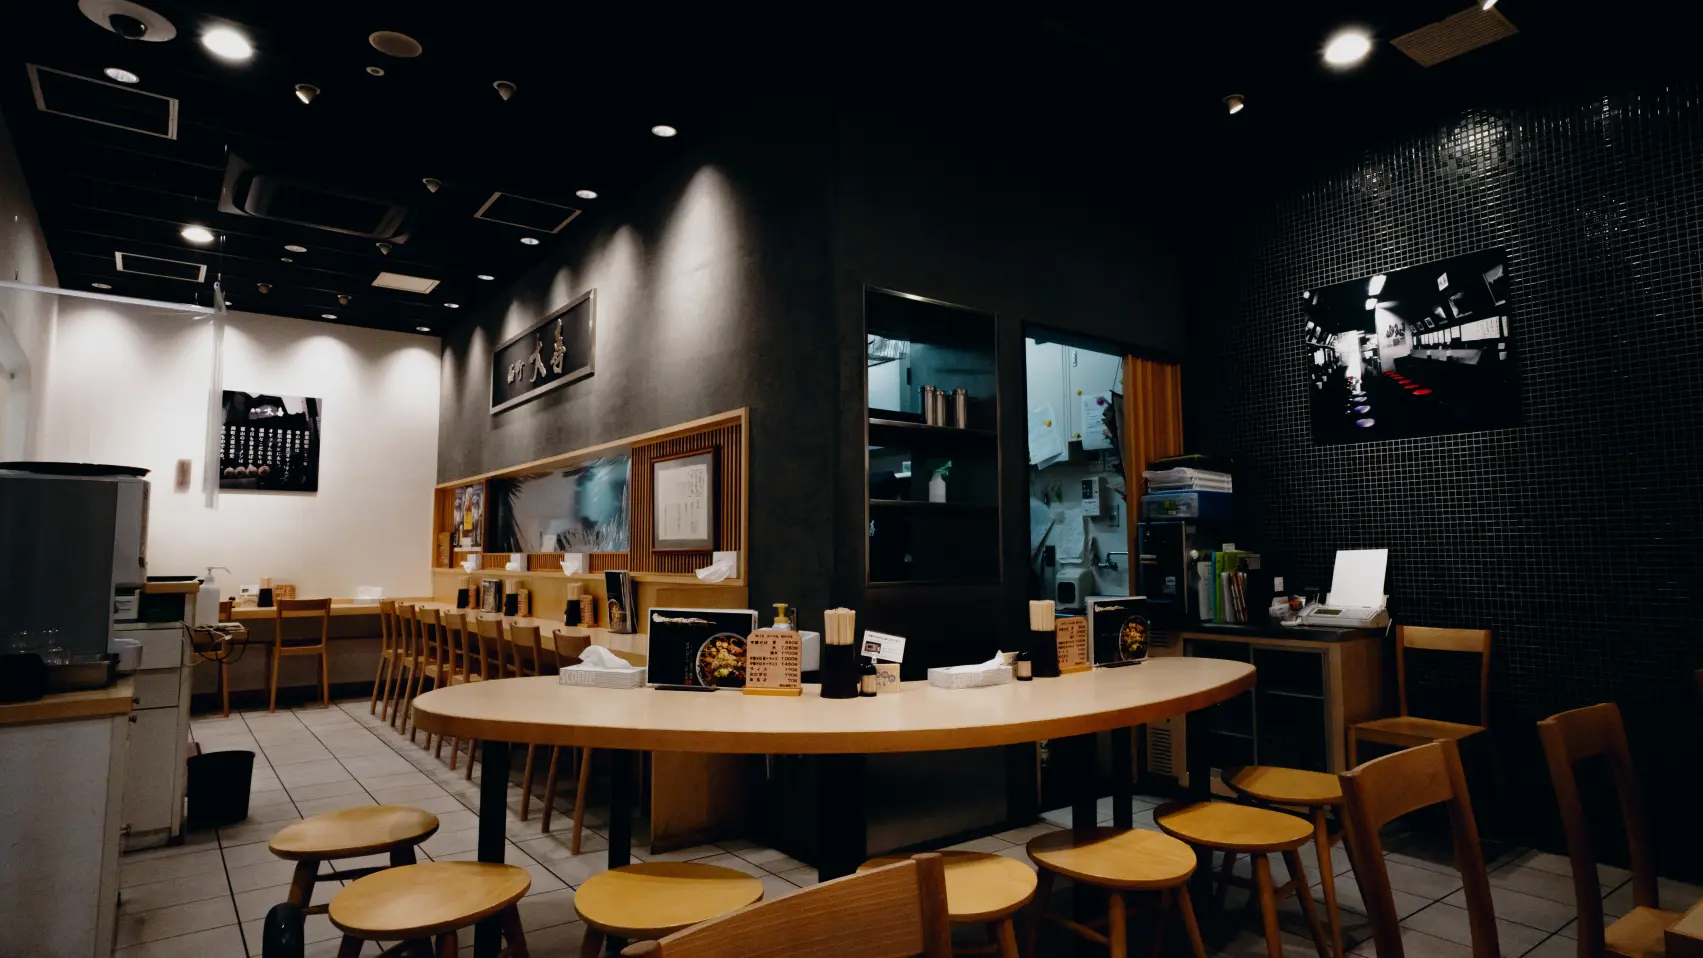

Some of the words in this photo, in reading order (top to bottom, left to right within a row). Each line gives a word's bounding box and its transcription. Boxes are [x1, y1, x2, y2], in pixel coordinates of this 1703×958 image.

[238, 426, 246, 463] 富山のラーメンは
